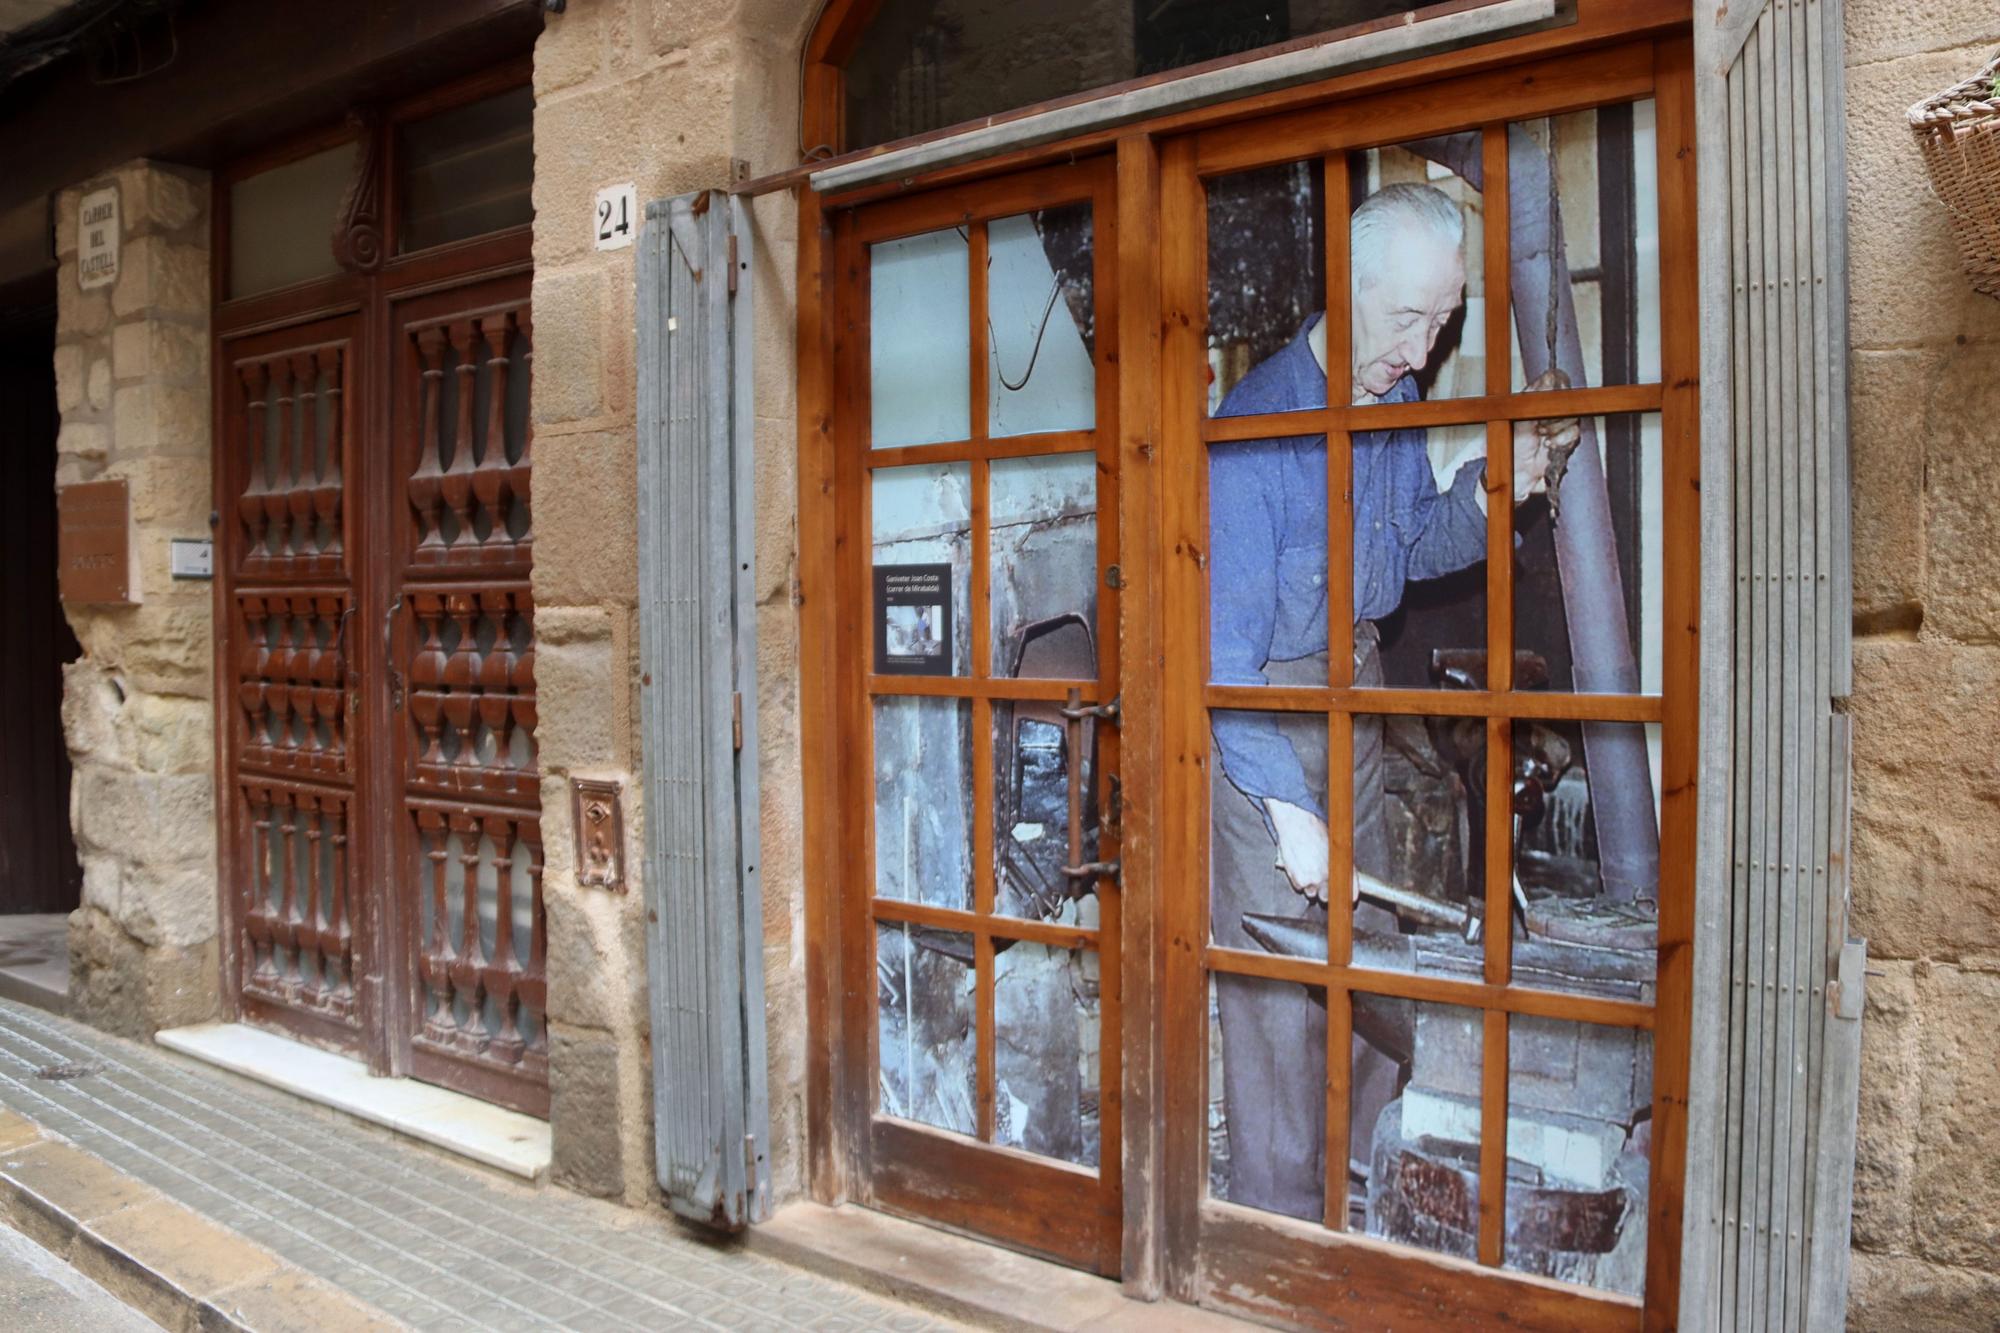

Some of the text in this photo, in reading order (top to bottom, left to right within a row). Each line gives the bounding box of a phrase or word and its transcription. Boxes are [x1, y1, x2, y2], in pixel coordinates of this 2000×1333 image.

[83, 202, 113, 226] CARRER
[599, 195, 629, 240] 24
[90, 230, 104, 248] DEL
[81, 252, 114, 273] CASTELL
[911, 574, 923, 582] Joan
[923, 574, 939, 582] Costa
